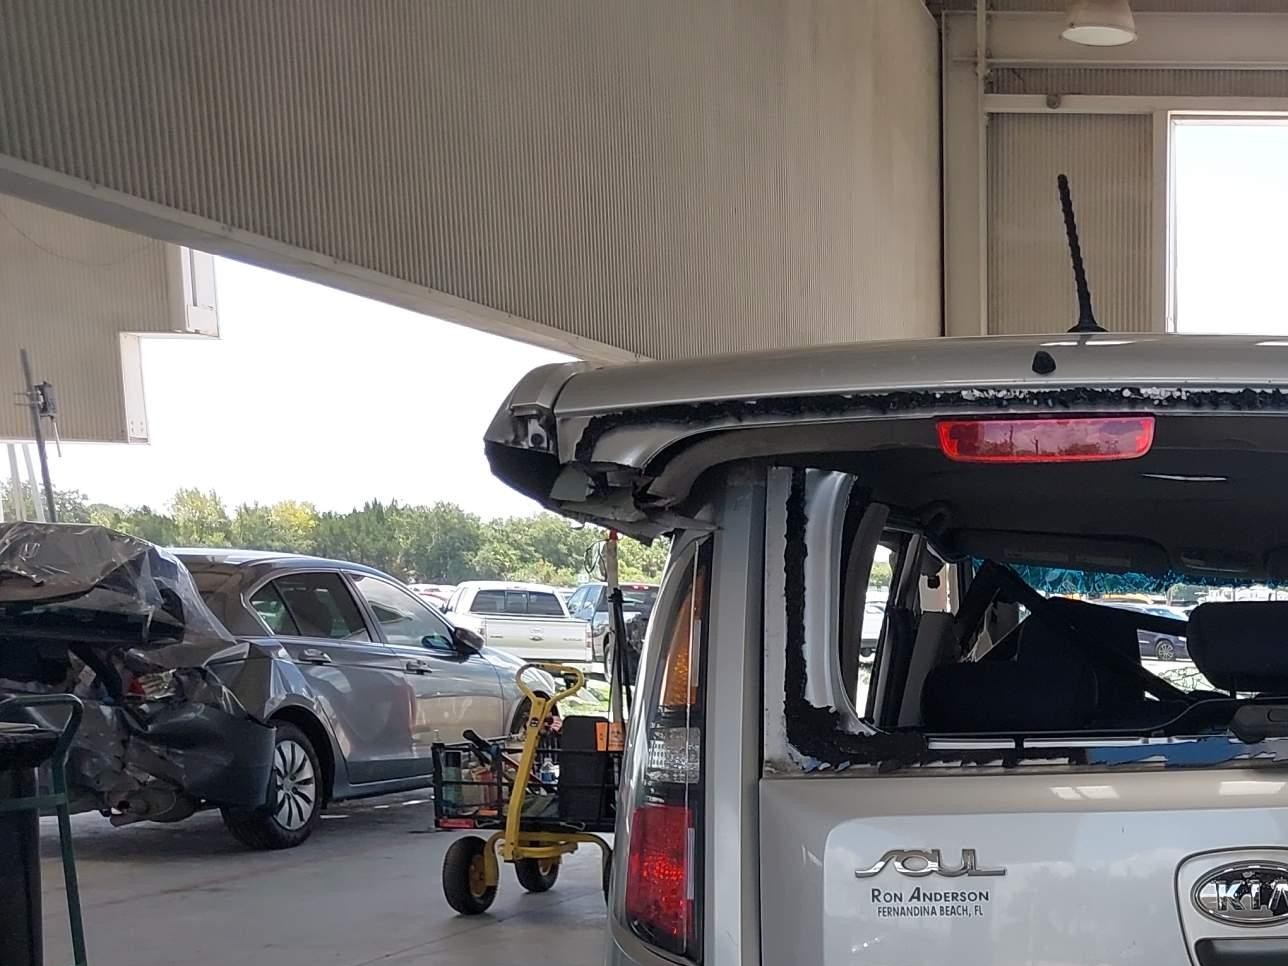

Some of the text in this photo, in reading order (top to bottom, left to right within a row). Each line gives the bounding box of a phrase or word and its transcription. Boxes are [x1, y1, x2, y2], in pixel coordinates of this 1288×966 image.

[855, 848, 1007, 878] SOUL
[877, 905, 984, 917] FERNANDINA BEACH, FL
